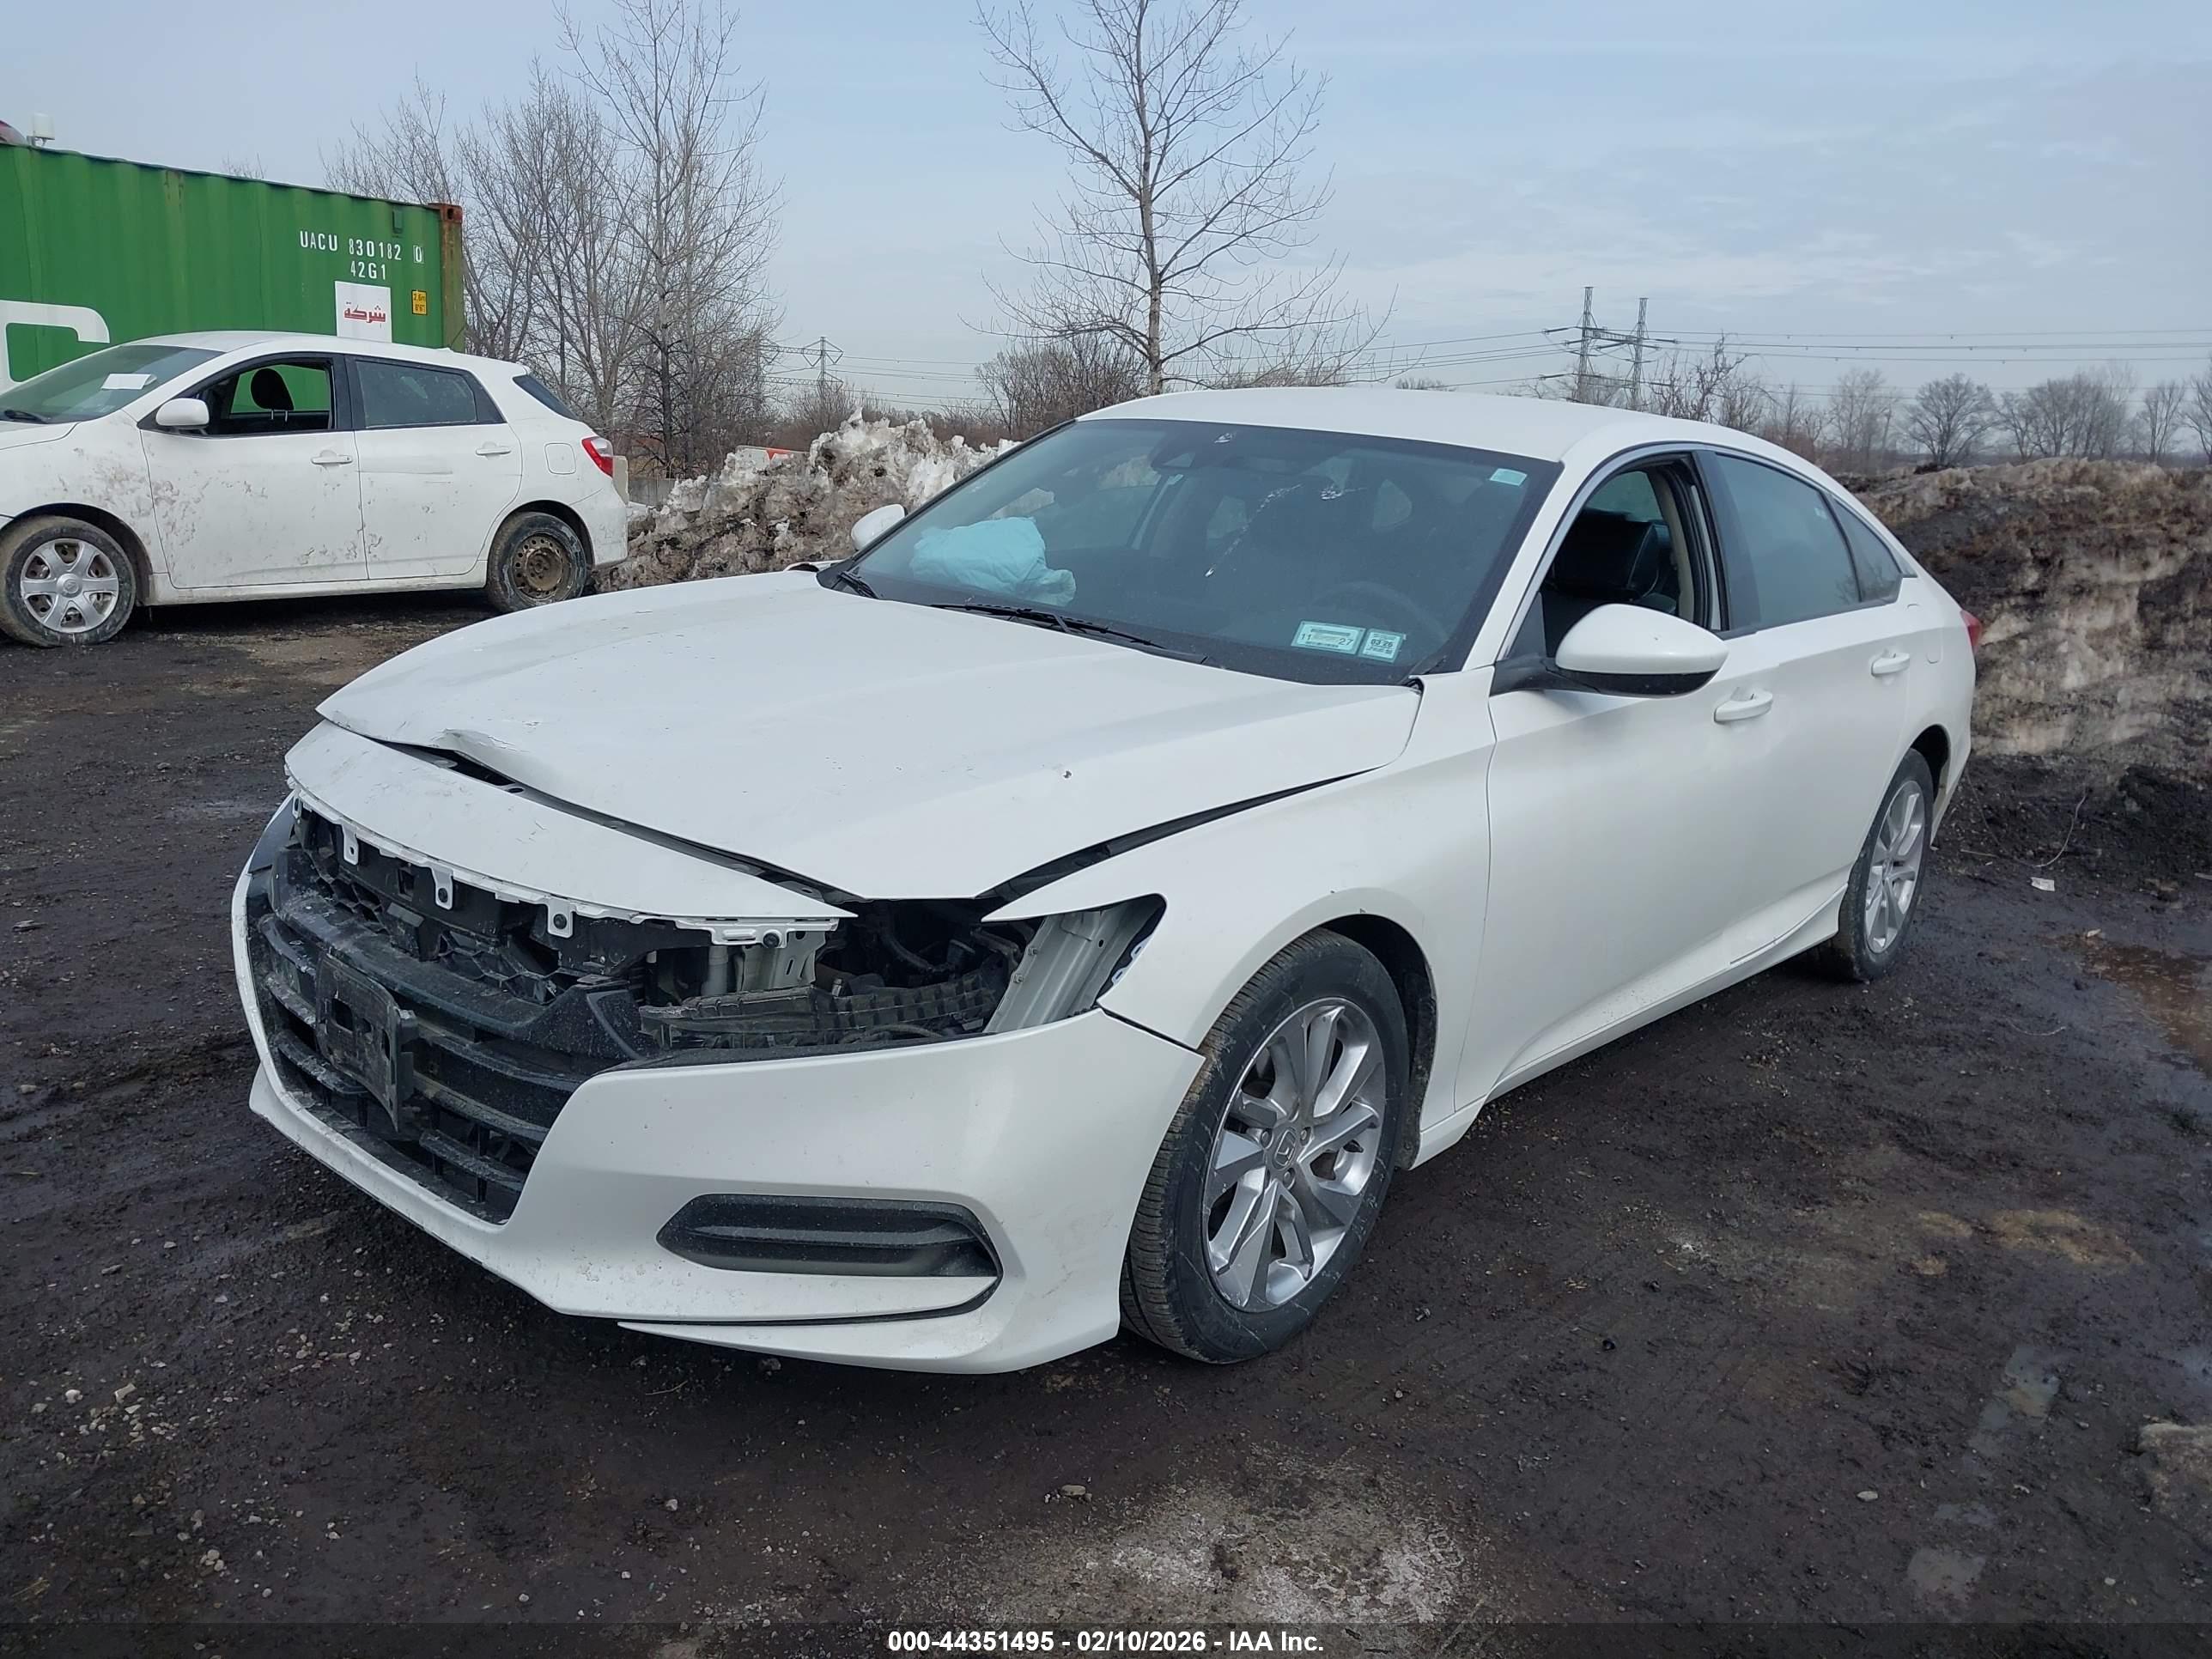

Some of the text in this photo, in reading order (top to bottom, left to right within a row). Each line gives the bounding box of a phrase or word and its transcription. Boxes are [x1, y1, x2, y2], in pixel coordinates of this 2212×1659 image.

[300, 230, 337, 252] UACU
[349, 238, 402, 261] 830182
[350, 260, 386, 280] 42G1
[1338, 637, 1354, 646] 27
